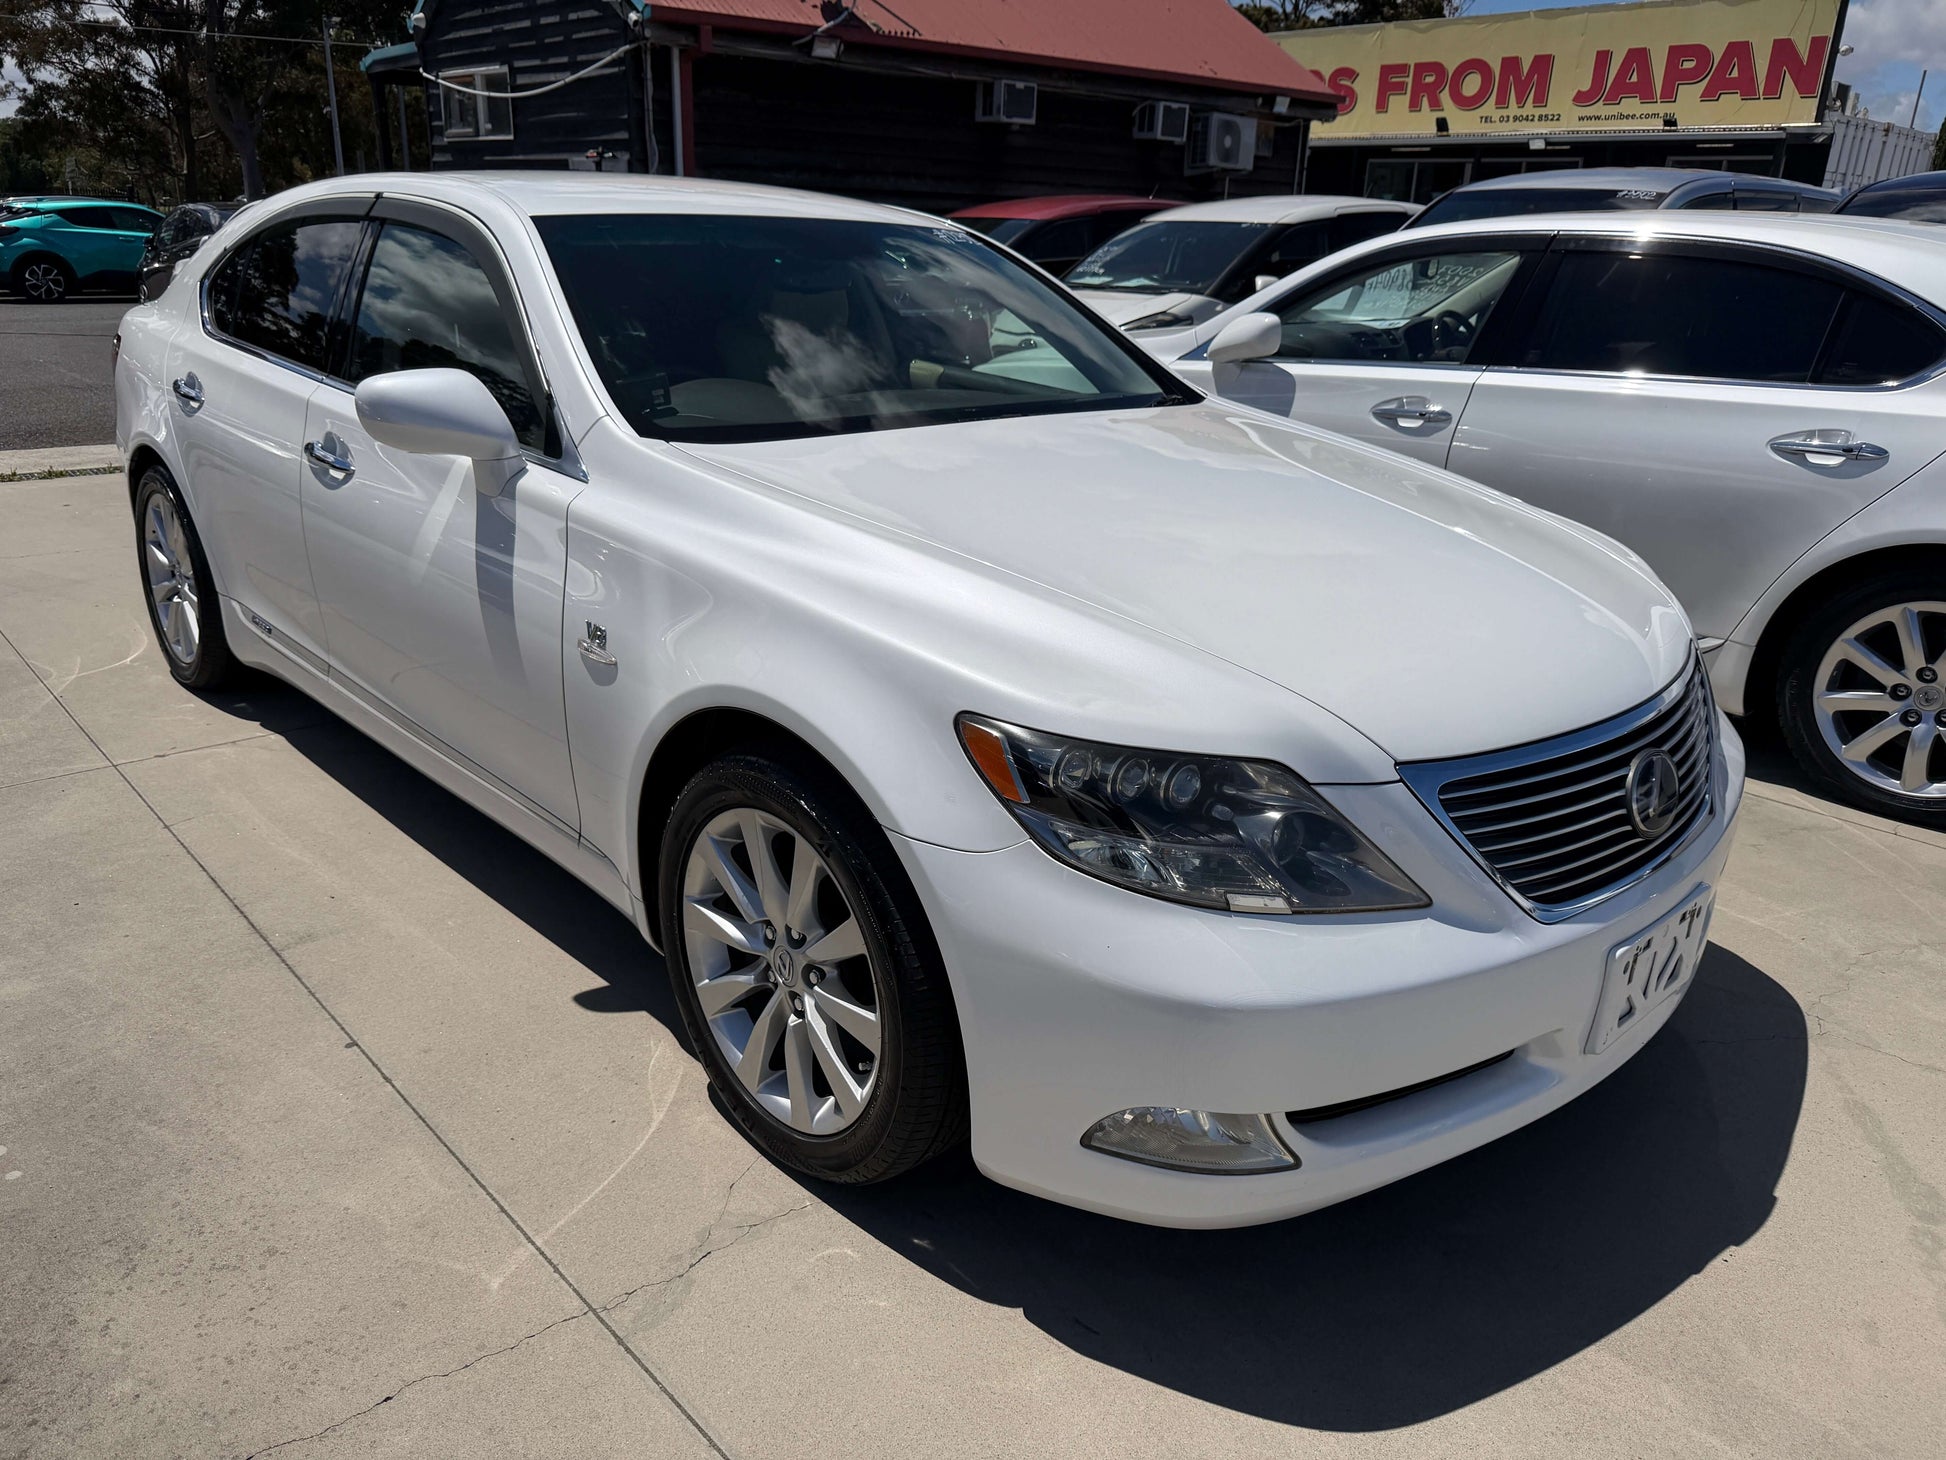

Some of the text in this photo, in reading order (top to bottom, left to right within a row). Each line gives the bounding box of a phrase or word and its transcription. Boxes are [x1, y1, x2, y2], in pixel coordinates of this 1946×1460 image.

[1376, 54, 1555, 114] FROM
[1572, 35, 1830, 107] JAPAN
[1479, 112, 1562, 124] TEL. 03 9042 8522
[1578, 111, 1677, 122] www.unibee.com.au
